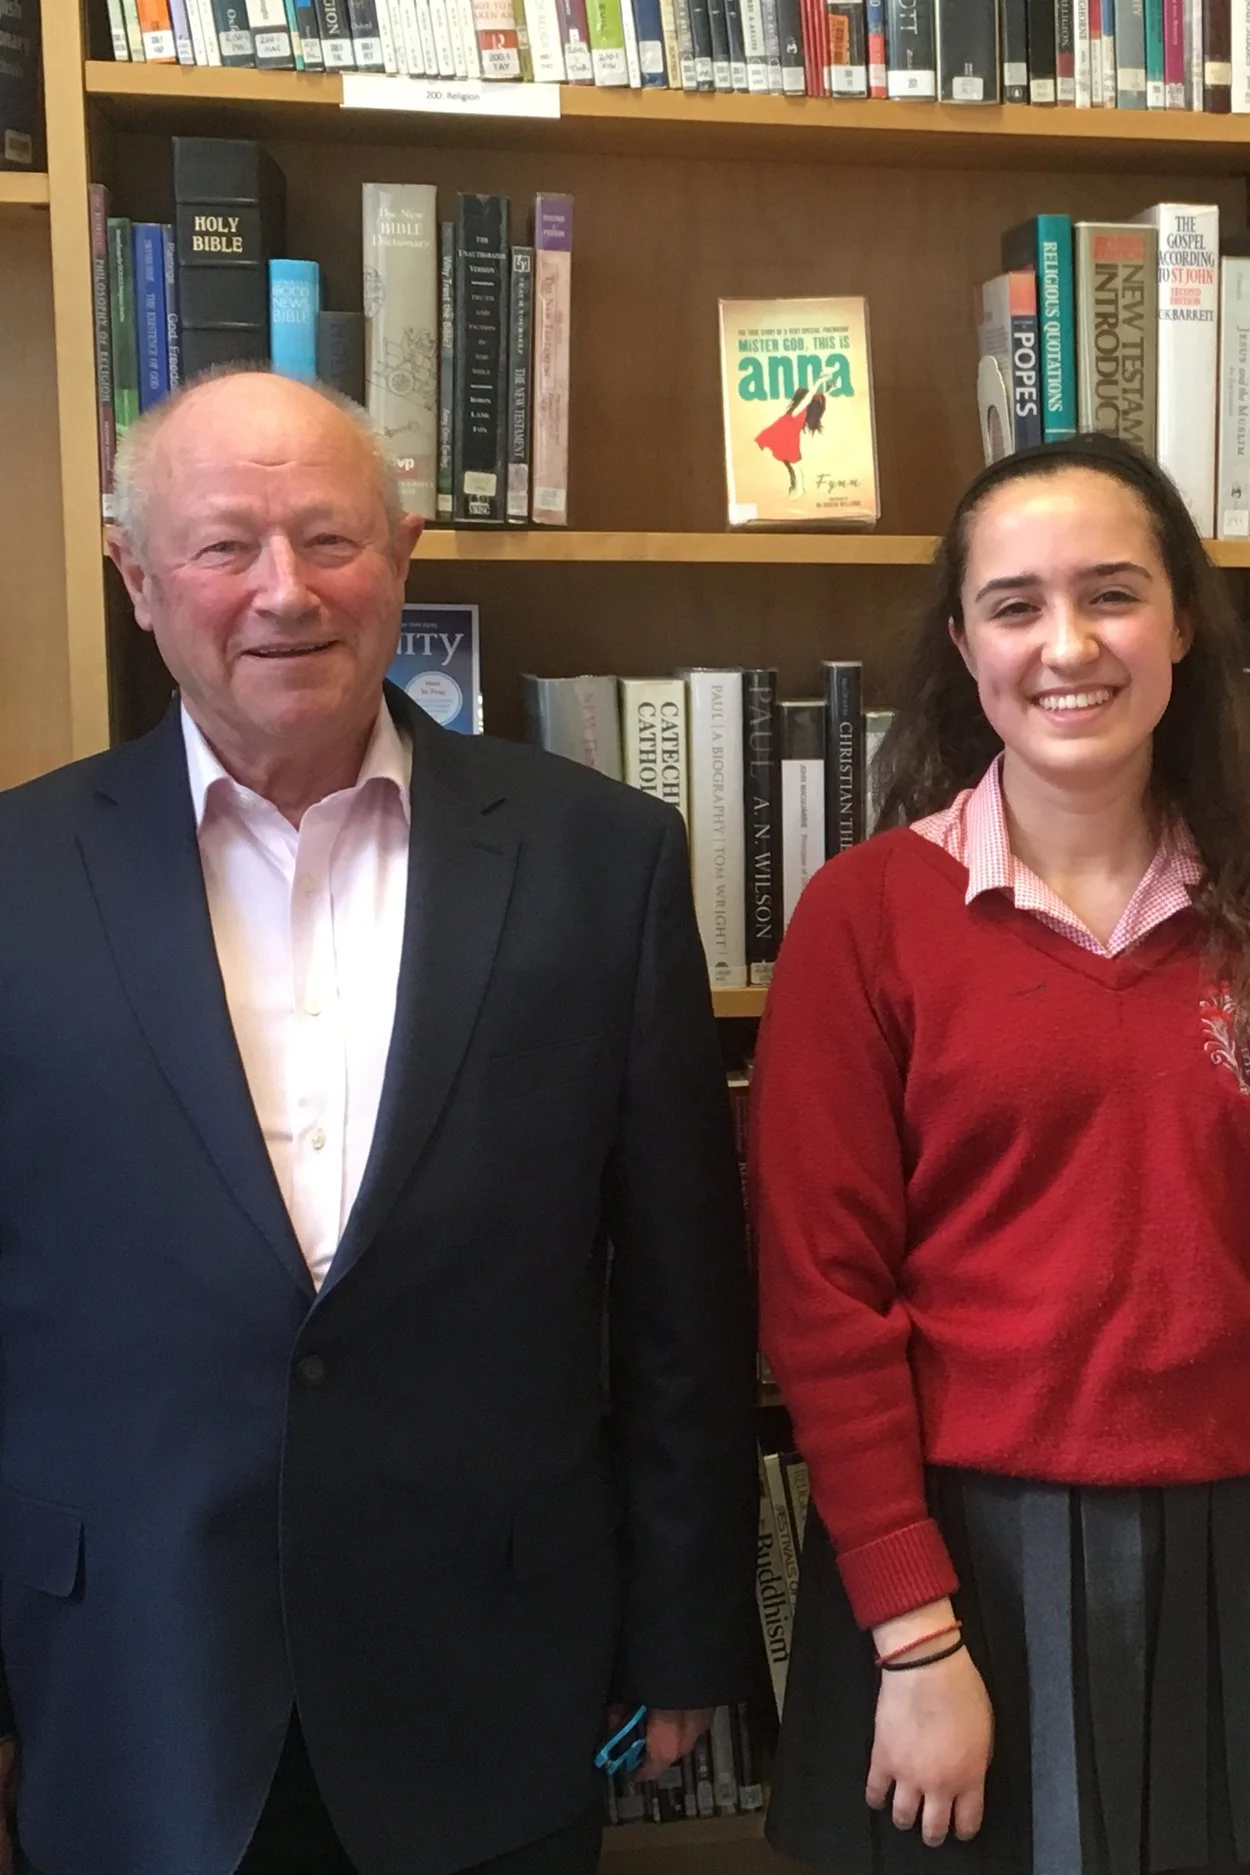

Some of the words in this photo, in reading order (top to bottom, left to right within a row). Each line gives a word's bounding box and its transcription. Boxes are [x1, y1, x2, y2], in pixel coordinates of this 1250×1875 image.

[426, 90, 444, 100] 200:
[446, 92, 480, 102] Religion
[194, 216, 240, 232] HOLY
[380, 220, 424, 237] BIBLE
[1175, 215, 1197, 233] THE
[192, 236, 243, 252] BIBLE
[372, 234, 431, 250] Dictionary
[1166, 234, 1206, 251] GOSPEL
[441, 256, 452, 277] Why
[1158, 251, 1216, 268] ACCORDING
[1042, 241, 1060, 318] RELIGIOUS
[1158, 267, 1170, 284] TO
[1171, 267, 1184, 284] ST
[1185, 267, 1214, 284] JOHN
[95, 259, 108, 326] PHILOSOPHY
[442, 279, 453, 302] Trust
[1121, 263, 1145, 332] NEW
[1170, 287, 1201, 297] SECOND
[272, 310, 309, 323] BIBLE
[442, 304, 453, 318] the
[442, 320, 453, 348] Bible?
[738, 337, 779, 353] MISTER
[783, 337, 809, 352] GOD,
[813, 336, 836, 350] THIS
[839, 335, 850, 349] IS
[1237, 327, 1250, 363] JESUS
[100, 352, 110, 402] RELIGION
[514, 369, 526, 385] THE
[738, 353, 854, 402] anna
[1013, 331, 1038, 418] POPES
[1043, 321, 1063, 413] QUOTATIONS
[1238, 368, 1249, 385] and
[514, 388, 526, 407] NEW
[1238, 387, 1249, 402] the
[514, 409, 526, 457] TESTAMENT
[1237, 406, 1249, 455] MUSLIM
[816, 473, 861, 494] Fynn
[710, 684, 722, 721] PAUL
[712, 731, 722, 741] A
[748, 686, 773, 778] PAUL
[711, 746, 725, 834] BIOGRAPHY
[753, 796, 769, 817] A.
[753, 823, 769, 845] N.
[713, 845, 726, 880] TOM
[753, 852, 772, 940] WILSON
[714, 884, 727, 948] WRIGHT
[756, 1532, 790, 1665] Buddhism
